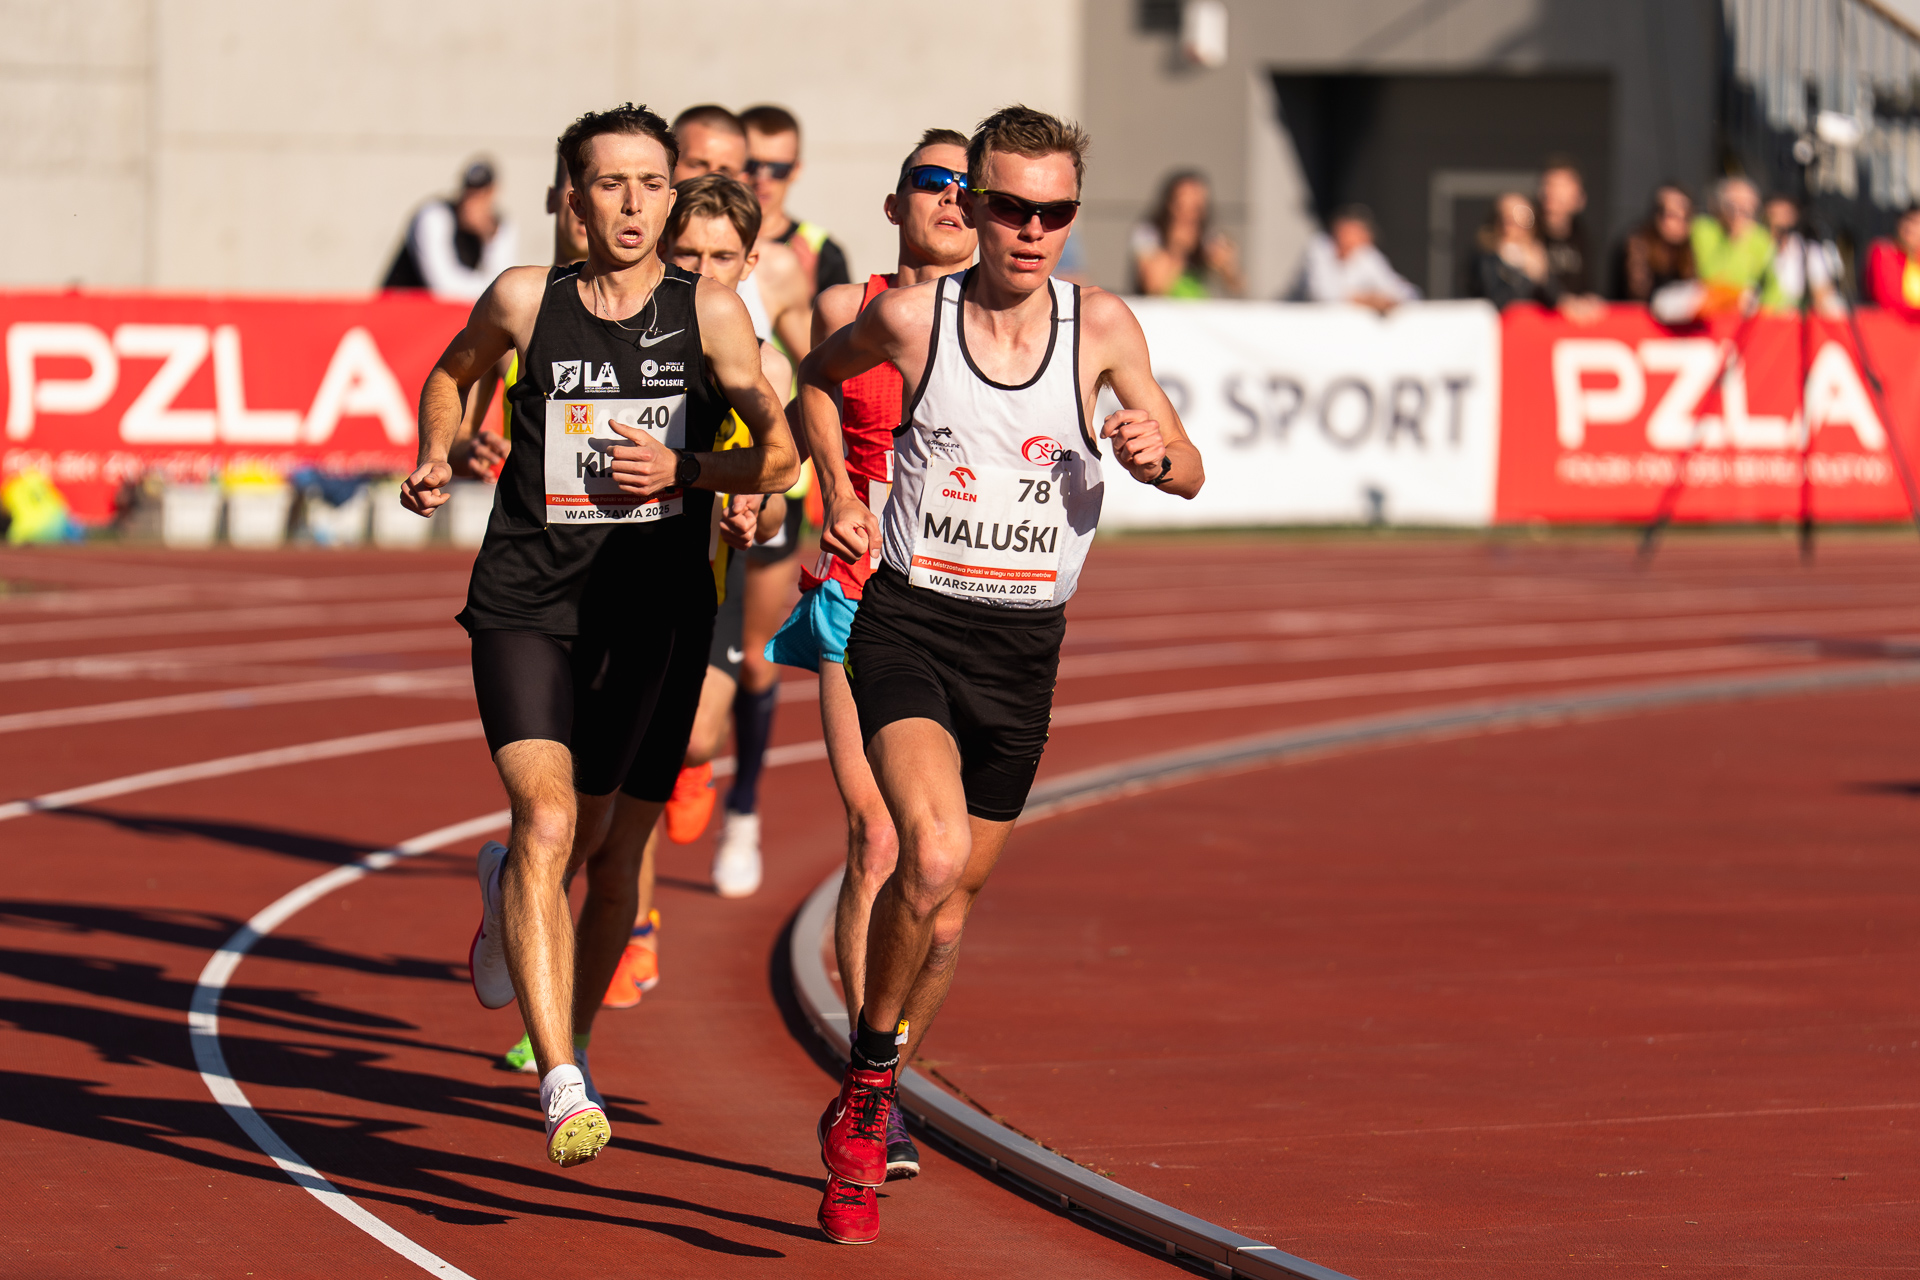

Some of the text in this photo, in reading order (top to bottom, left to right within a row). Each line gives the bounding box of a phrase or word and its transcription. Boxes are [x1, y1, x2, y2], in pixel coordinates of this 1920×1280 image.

[5, 321, 418, 446] PZLA
[646, 379, 684, 387] OPOLSKIE
[1553, 338, 1886, 450] PZLA
[637, 405, 670, 430] 40
[1220, 372, 1474, 449] SPORT
[566, 424, 592, 433] PZLA
[942, 488, 977, 503] ORLEN
[1018, 478, 1051, 504] 78
[565, 505, 670, 520] WARSZAWA 2025
[923, 512, 1058, 553] MALUŚKI
[918, 558, 932, 566] PZLA
[933, 561, 966, 573] Mistrzostwa
[929, 574, 1037, 595] WARSZAWA 2025
